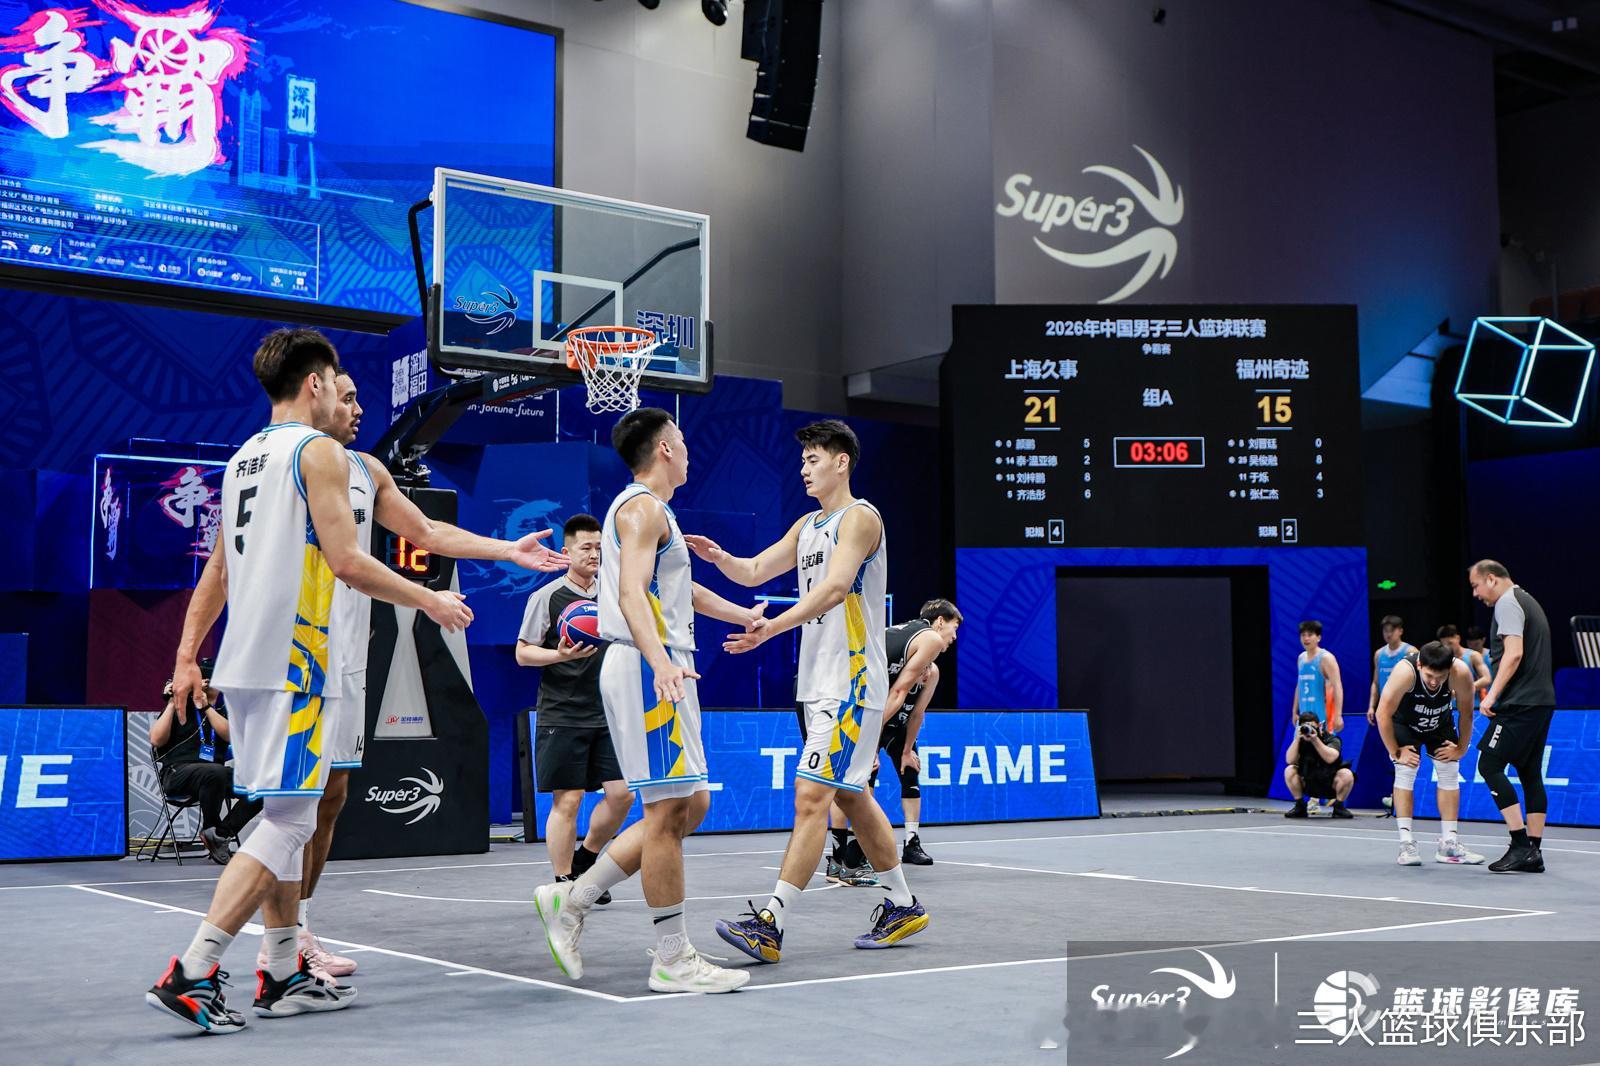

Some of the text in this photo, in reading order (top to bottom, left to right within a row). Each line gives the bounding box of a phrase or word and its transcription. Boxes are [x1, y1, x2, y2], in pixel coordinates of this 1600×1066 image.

[292, 83, 312, 127] 深圳
[996, 173, 1135, 236] Super3
[453, 296, 499, 313] Super3
[636, 310, 695, 349] 深圳
[1046, 319, 1266, 338] 2026年中国男子三人篮球联赛
[1005, 359, 1078, 379] 上海久事
[1236, 359, 1309, 379] 福州奇迹
[1143, 388, 1173, 407] 组A
[1024, 396, 1057, 423] 21
[1257, 396, 1292, 423] 15
[1083, 438, 1090, 448] 5
[1130, 442, 1189, 462] 03:06
[1315, 438, 1322, 448] 0
[1083, 455, 1091, 465] 2
[1315, 455, 1322, 464] 8
[1084, 472, 1091, 482] 8
[1316, 472, 1323, 481] 4
[1084, 489, 1091, 499] 6
[1317, 488, 1324, 498] 3
[235, 485, 258, 555] 5
[1052, 526, 1060, 537] 4
[1285, 525, 1293, 536] 2
[1418, 716, 1440, 728] 25
[808, 752, 820, 770] 0
[918, 744, 1067, 786] GAME
[365, 786, 421, 804] Super3
